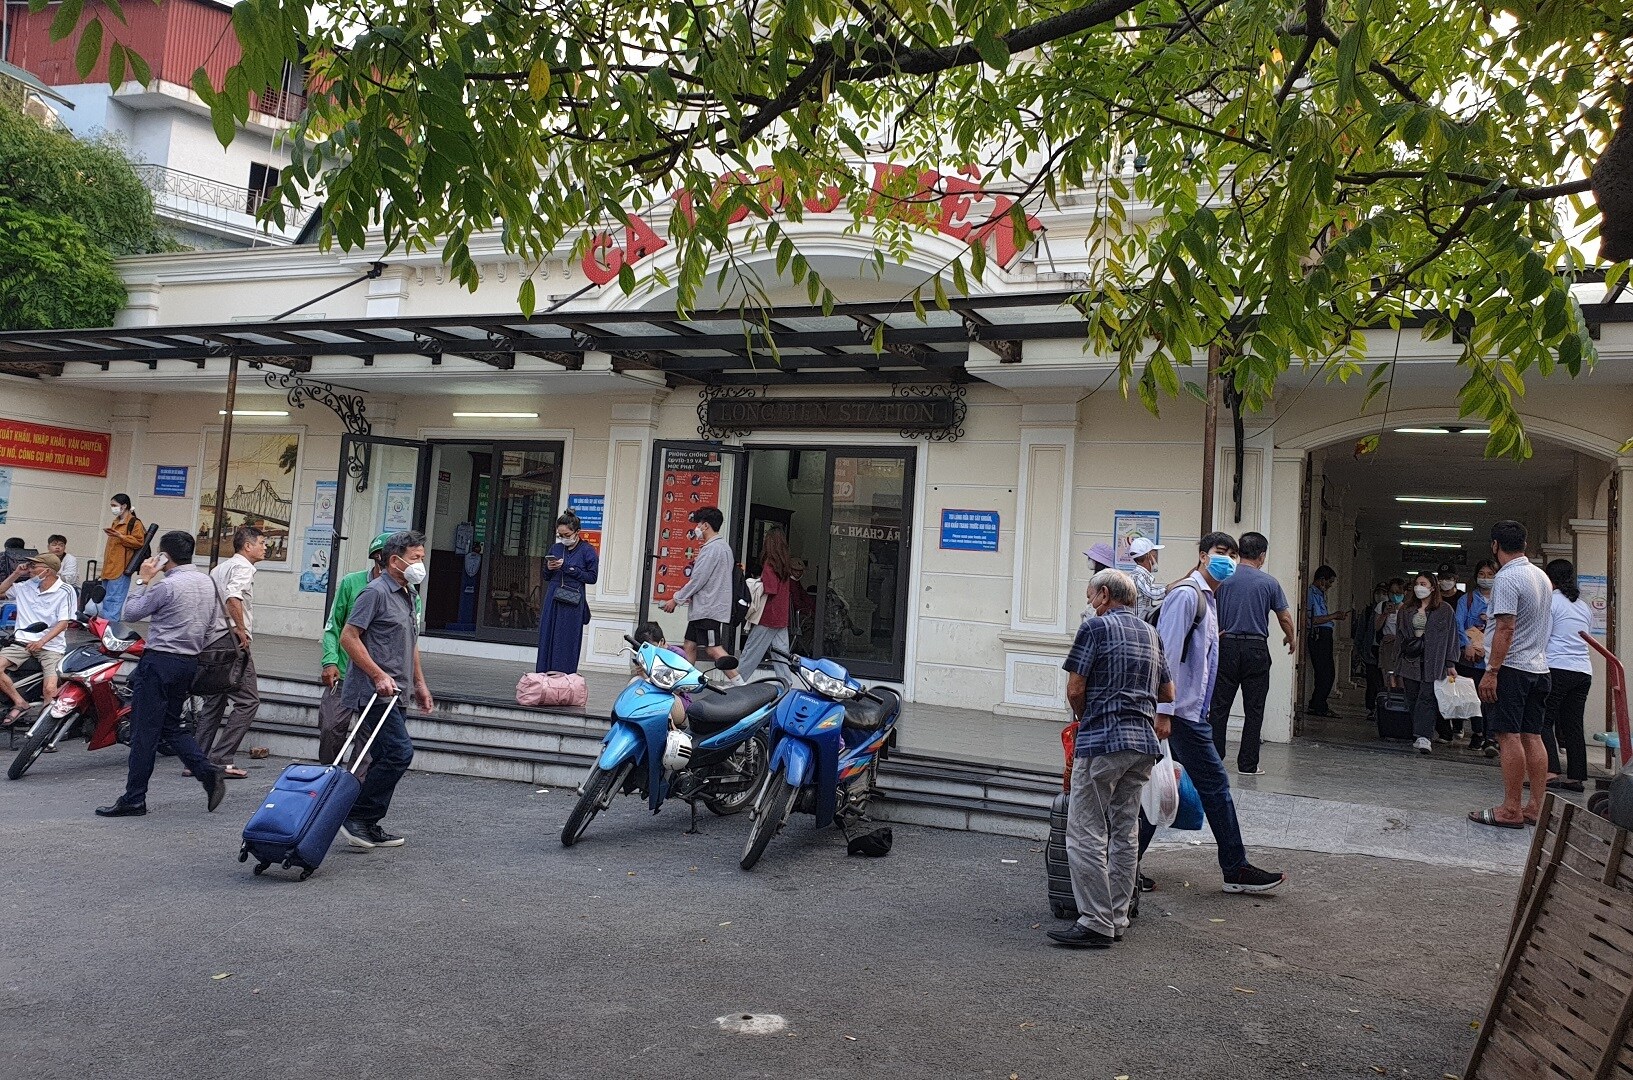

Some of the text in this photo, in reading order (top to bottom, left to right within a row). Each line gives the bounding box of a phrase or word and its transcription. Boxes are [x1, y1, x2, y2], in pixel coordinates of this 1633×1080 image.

[582, 213, 667, 285] GA
[839, 402, 937, 422] STATION
[800, 695, 819, 705] HONDA
